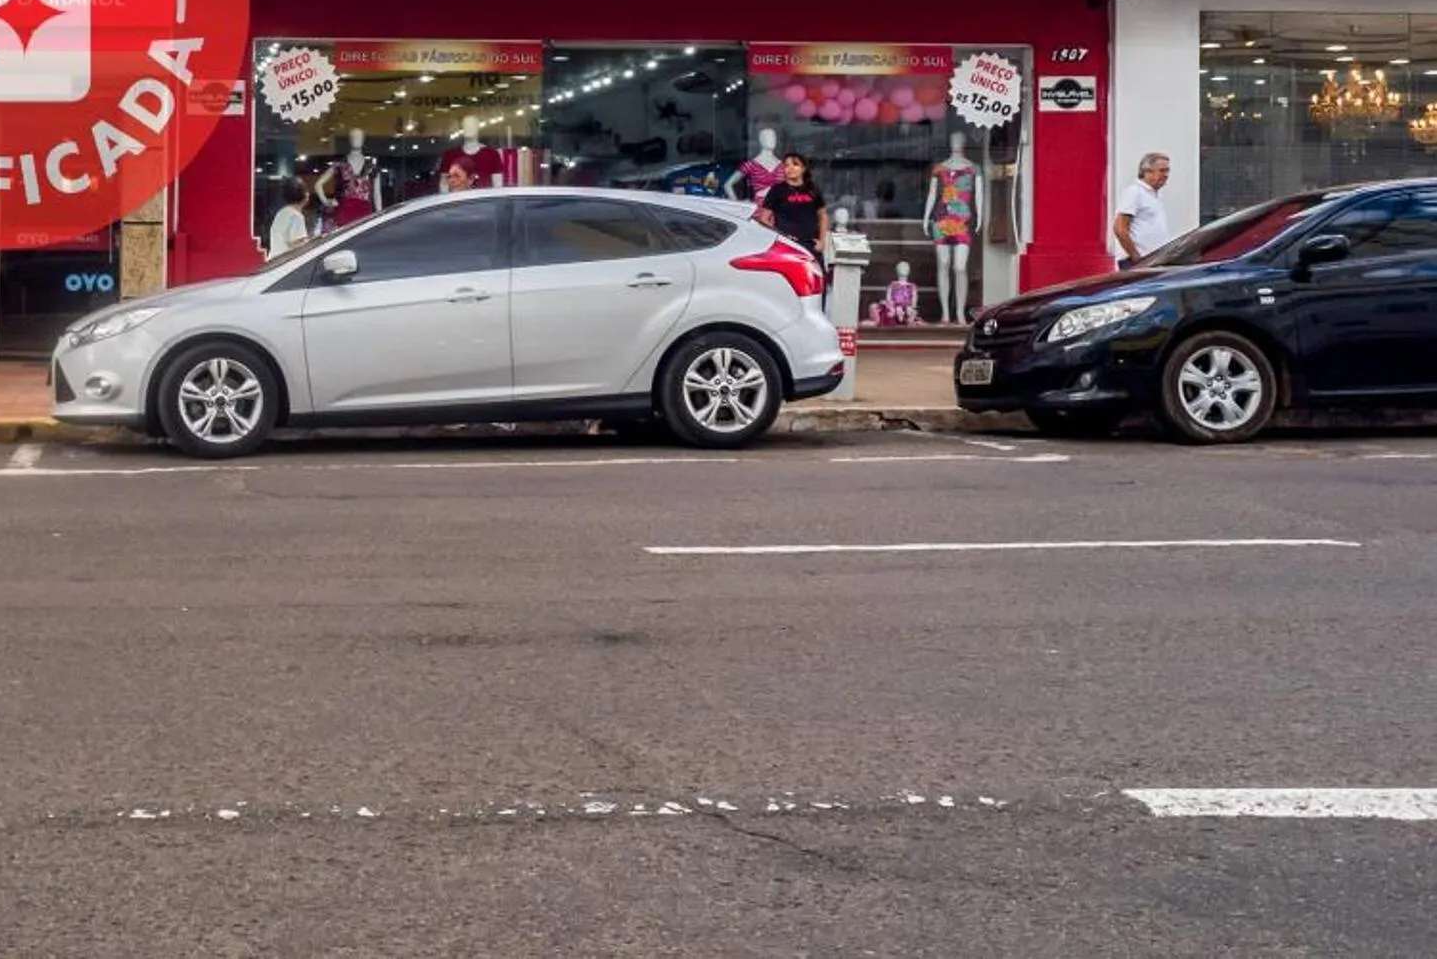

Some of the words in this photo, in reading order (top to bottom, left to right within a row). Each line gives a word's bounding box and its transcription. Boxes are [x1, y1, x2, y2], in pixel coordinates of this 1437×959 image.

[274, 52, 310, 74] PREÇO
[513, 53, 537, 64] SUL
[752, 54, 800, 66] DIRETO
[923, 56, 948, 67] SUL
[975, 58, 1014, 81] PREÇO
[292, 80, 333, 107] 15,00
[971, 93, 1012, 116] 15,00
[65, 274, 114, 291] OYO
